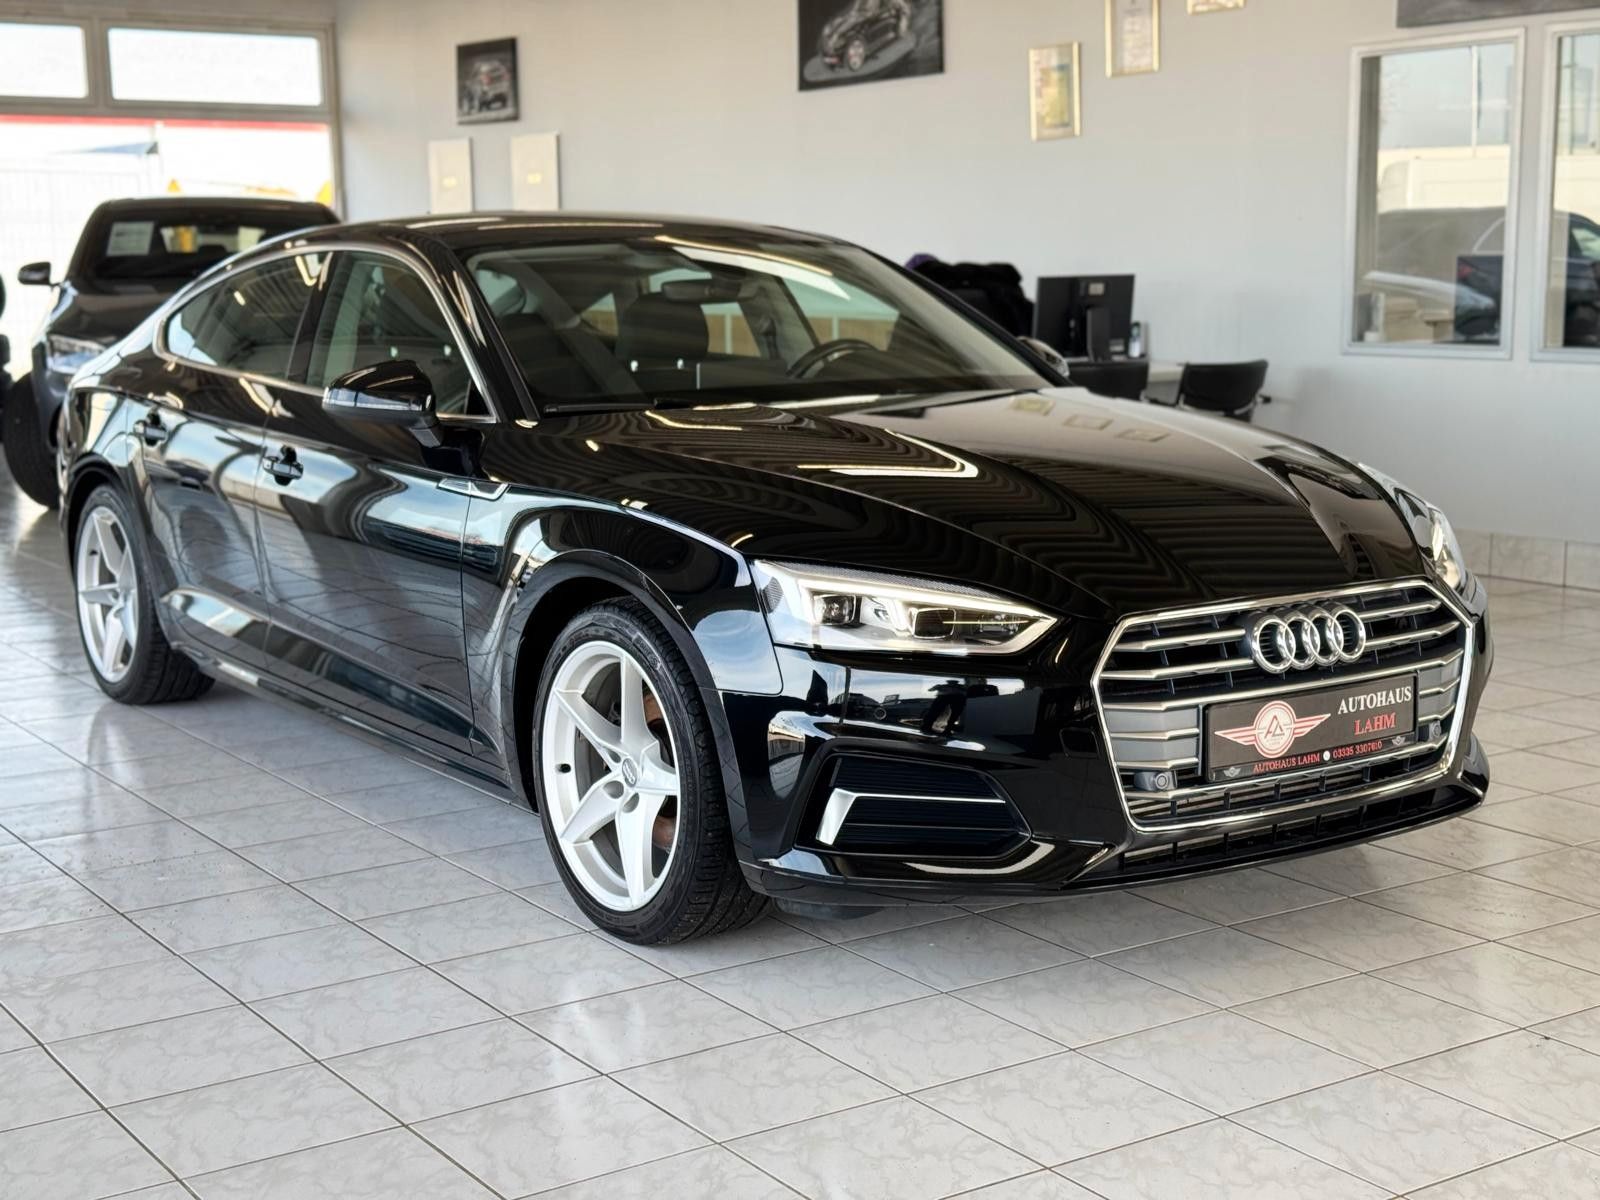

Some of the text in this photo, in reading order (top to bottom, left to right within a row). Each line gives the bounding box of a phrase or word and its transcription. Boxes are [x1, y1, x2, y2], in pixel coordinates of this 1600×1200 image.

[1337, 686, 1412, 715] AUTOHAUS
[1354, 712, 1396, 736] LAHM
[1253, 757, 1296, 774] AUTOHAUS
[1297, 752, 1320, 765] LAHM
[1332, 746, 1354, 759] 03335
